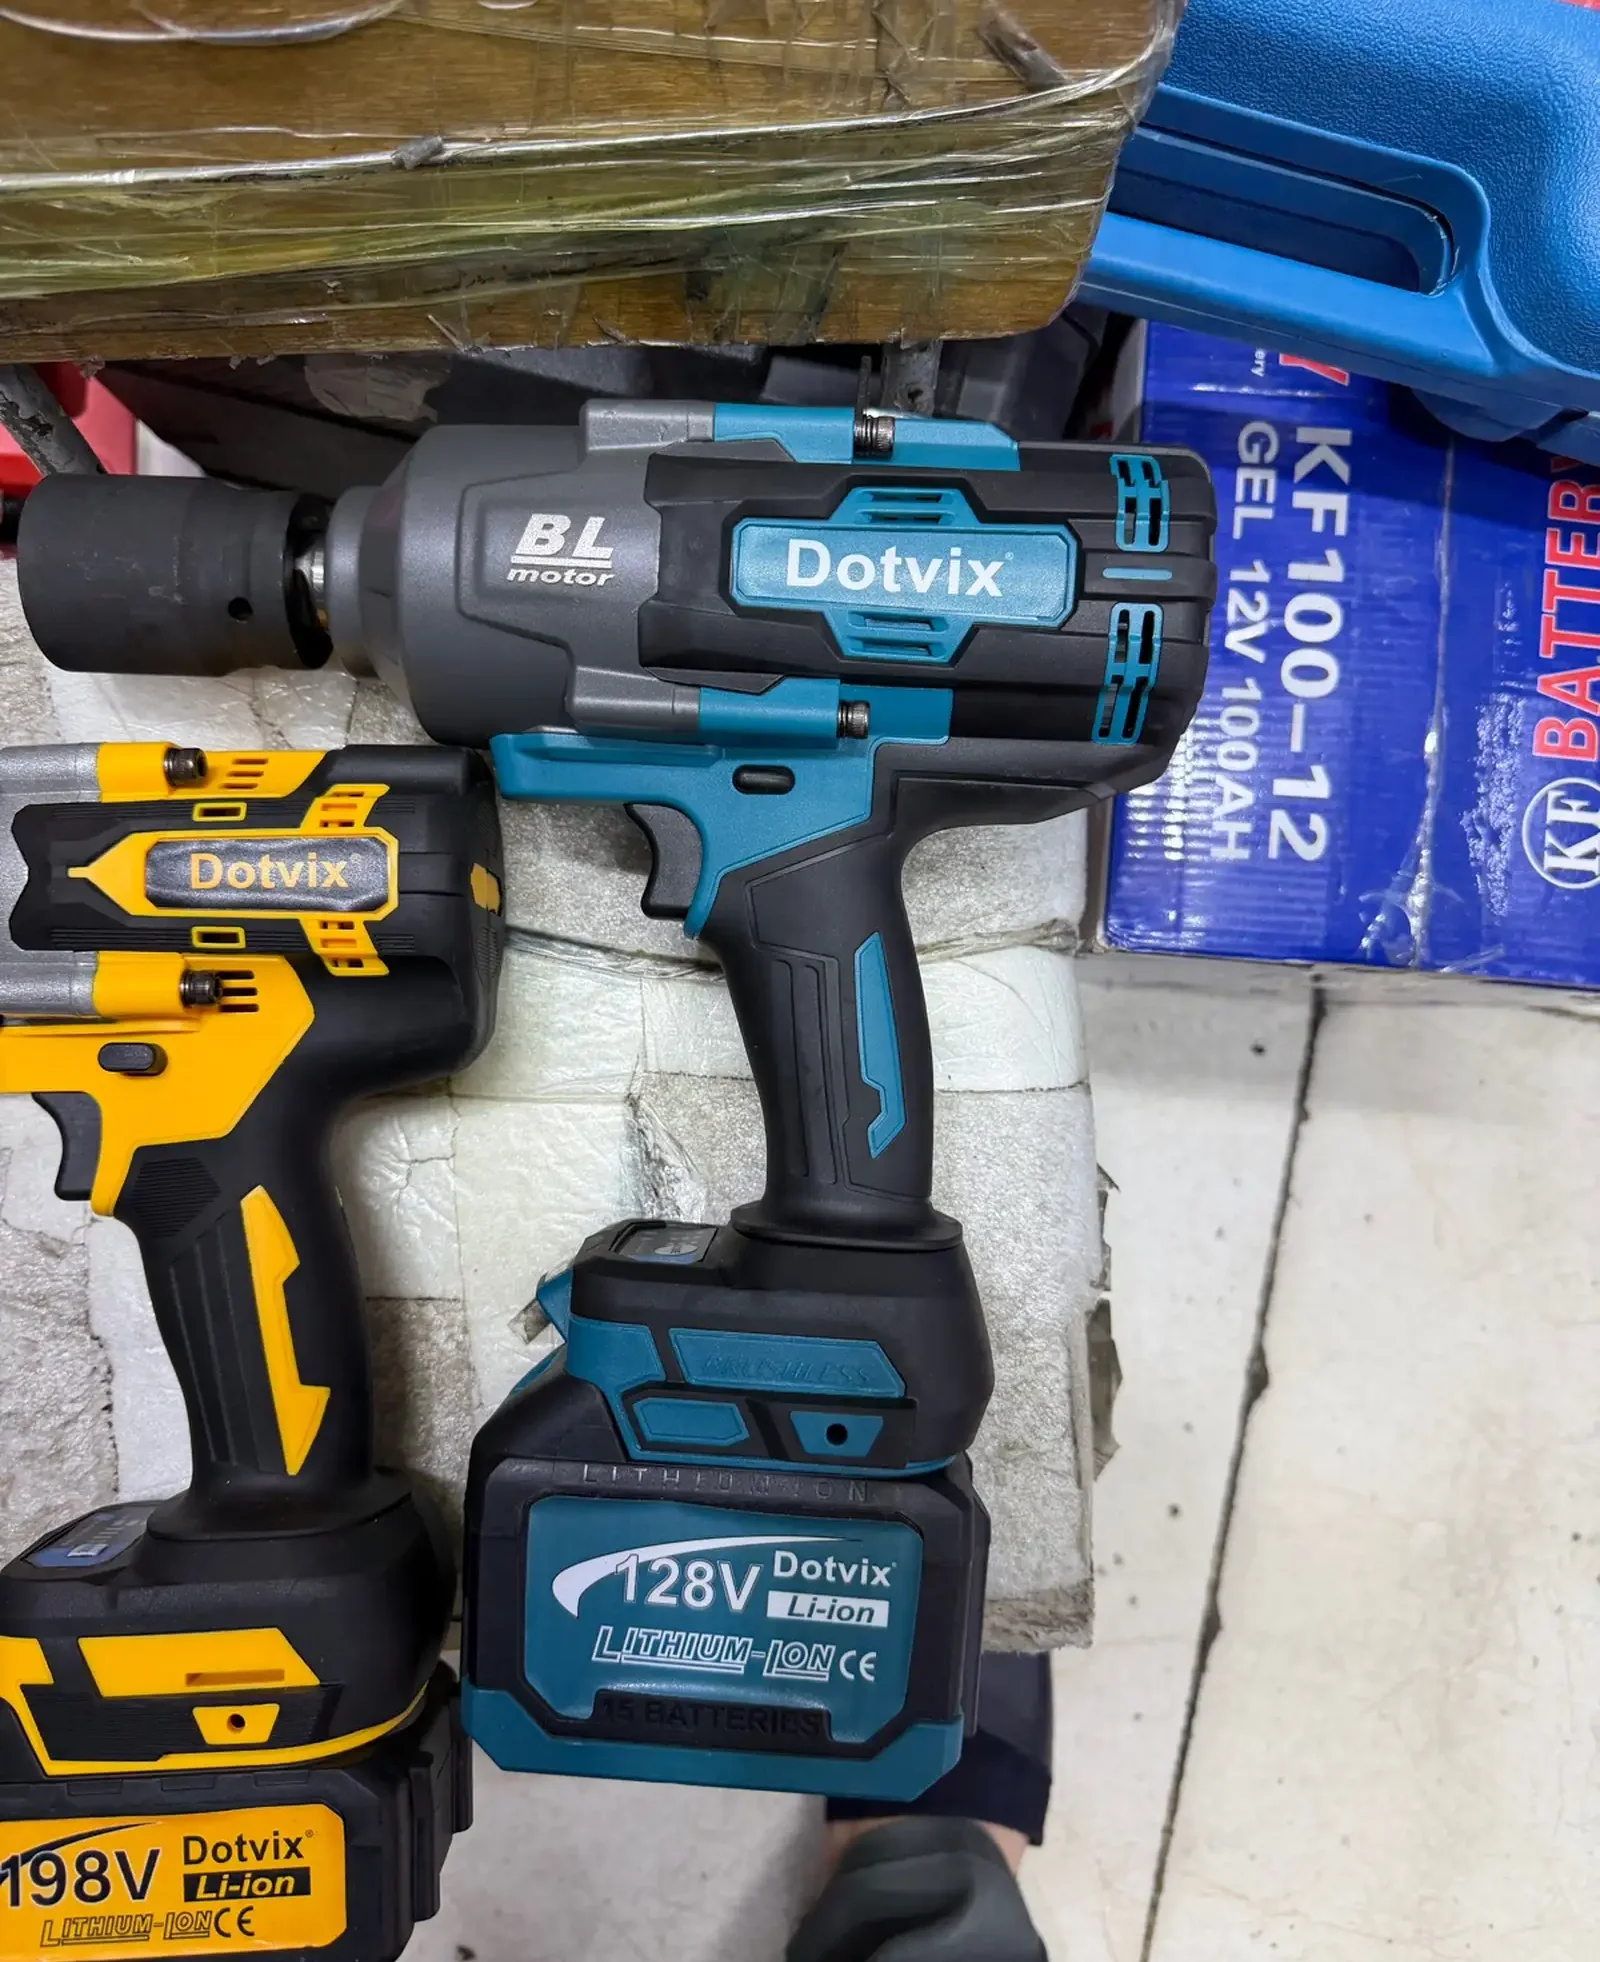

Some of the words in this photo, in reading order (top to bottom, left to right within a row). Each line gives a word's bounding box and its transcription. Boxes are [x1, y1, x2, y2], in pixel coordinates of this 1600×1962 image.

[1233, 421, 1279, 539] GEL
[515, 513, 614, 559] BL
[507, 568, 615, 586] motor
[1225, 560, 1272, 664] 12V
[1267, 427, 1352, 862] KF100-12
[1210, 677, 1263, 860] 100AH
[614, 1554, 763, 1614] 128V
[787, 1595, 876, 1624] Li-ion
[0, 1847, 162, 1909] 198V
[195, 1873, 295, 1899] Li-ion
